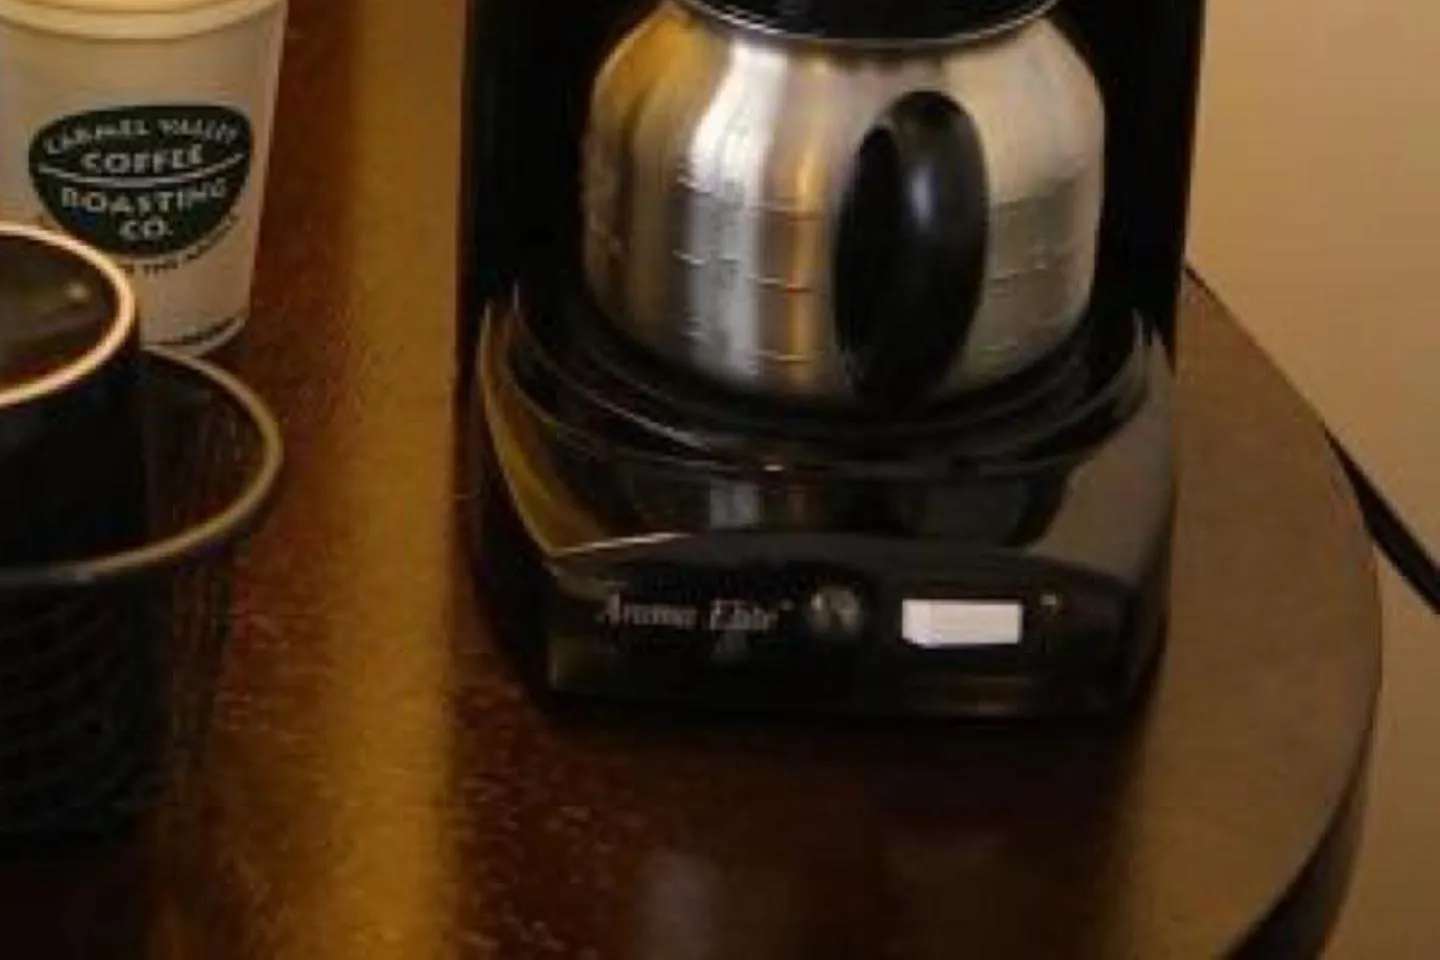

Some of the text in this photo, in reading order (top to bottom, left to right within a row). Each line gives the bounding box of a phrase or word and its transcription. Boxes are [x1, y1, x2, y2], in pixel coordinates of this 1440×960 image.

[43, 117, 239, 154] CARMEL VALLEY
[80, 143, 204, 174] COFFEE
[61, 177, 228, 213] ROASTING
[118, 217, 174, 240] CO.
[596, 592, 700, 632] Aroma
